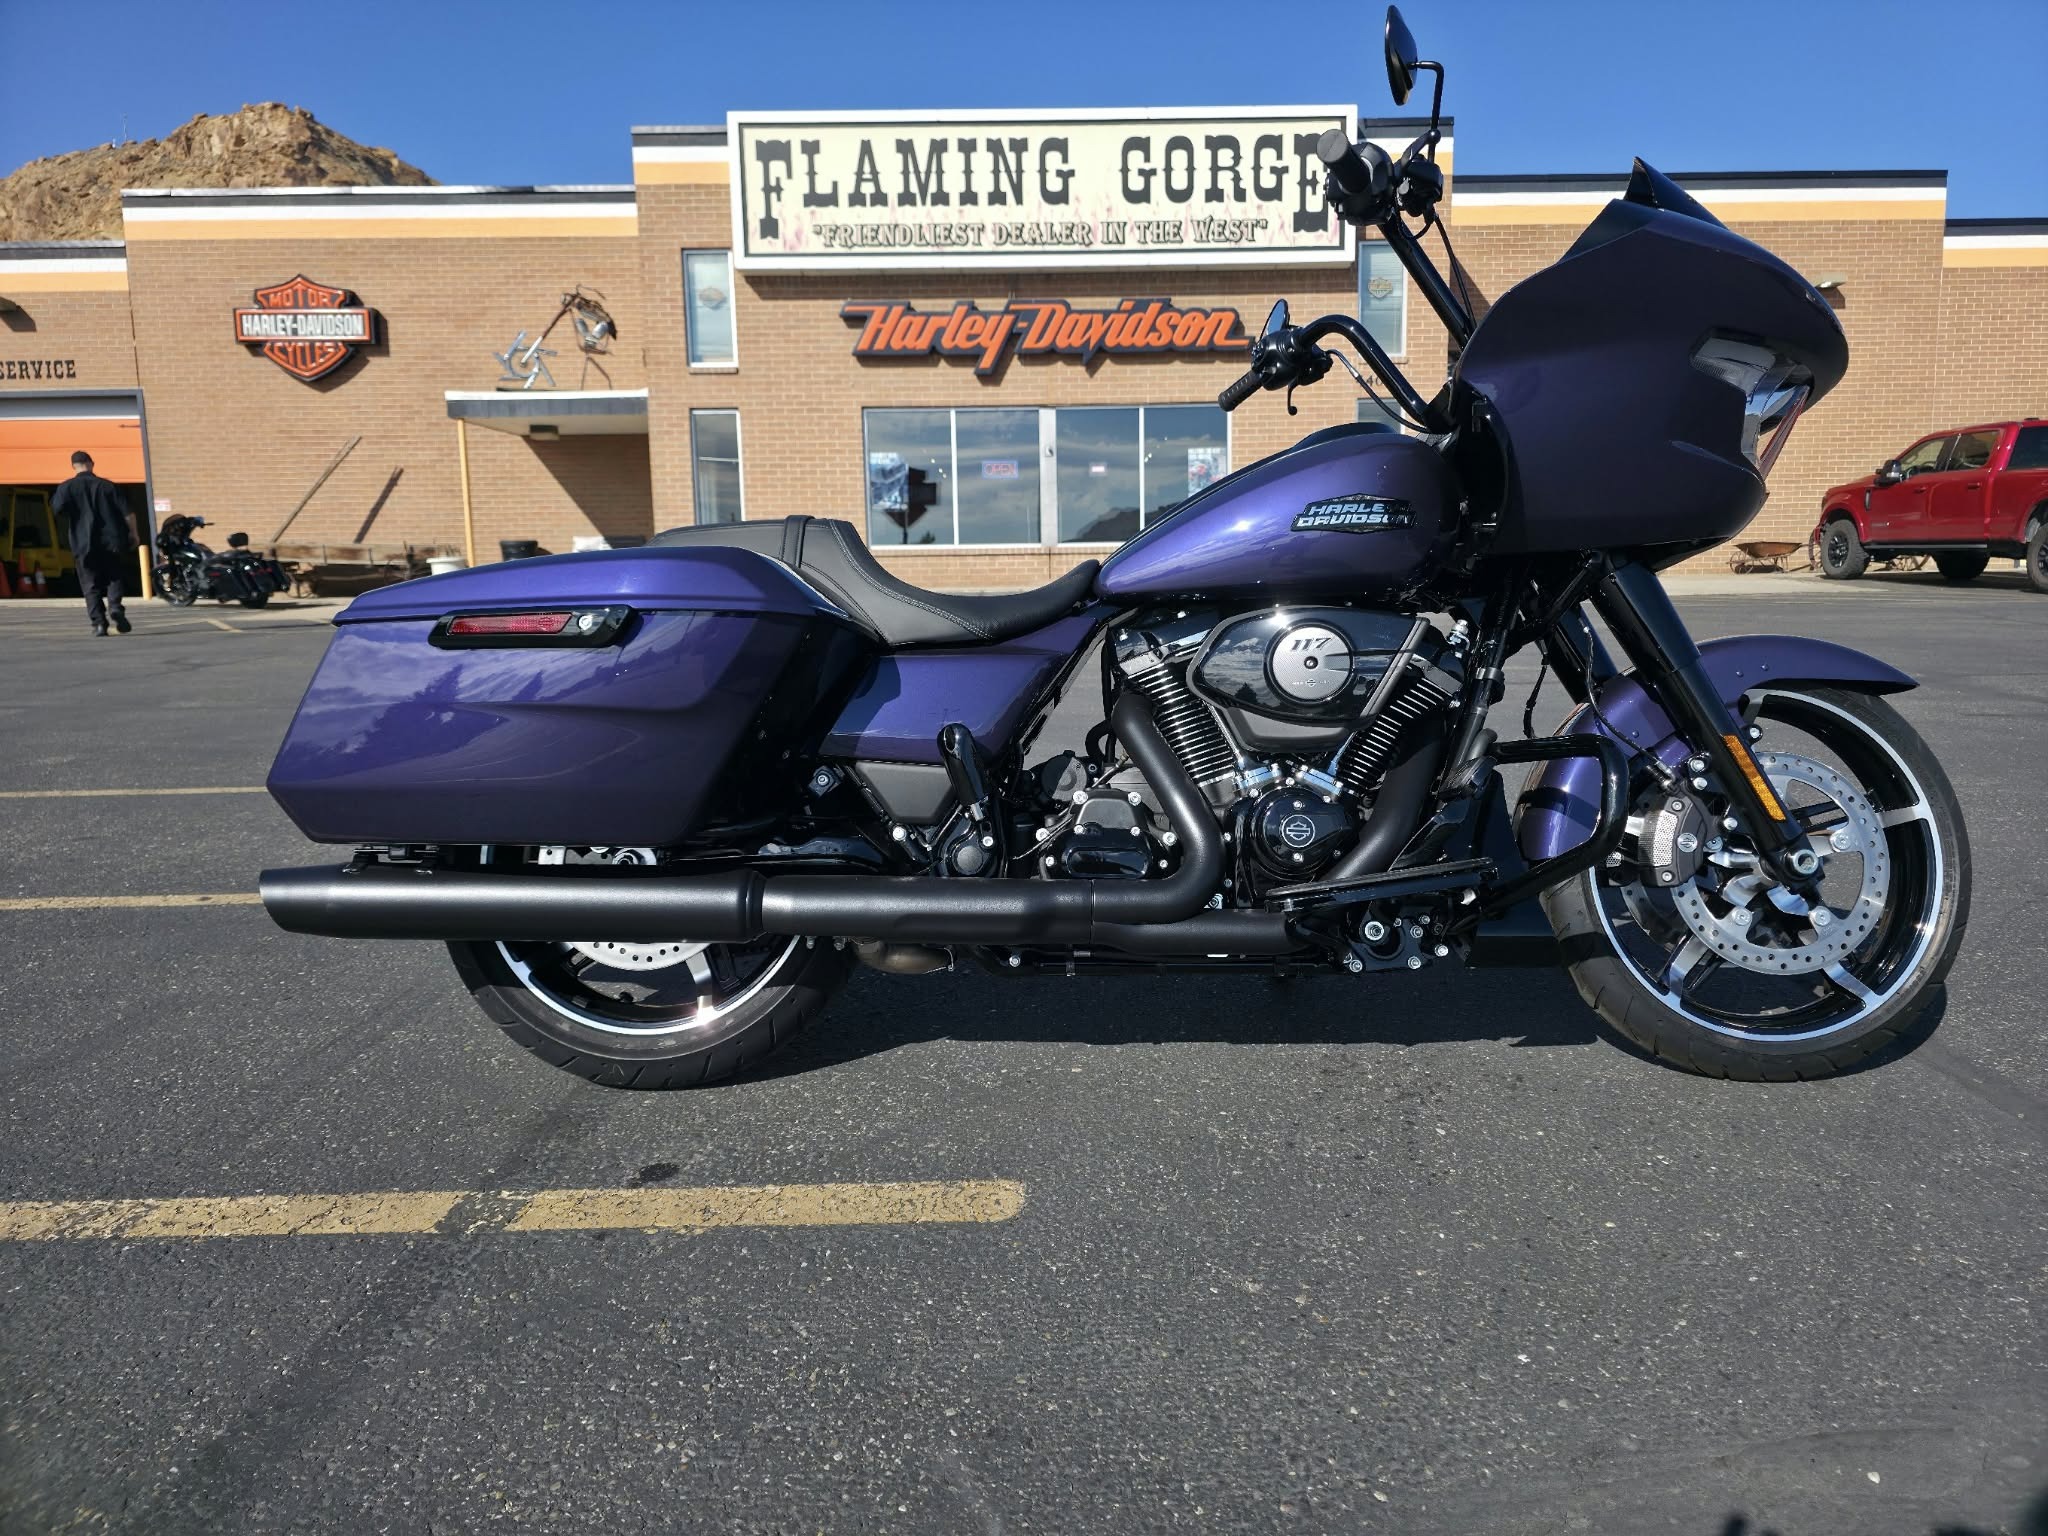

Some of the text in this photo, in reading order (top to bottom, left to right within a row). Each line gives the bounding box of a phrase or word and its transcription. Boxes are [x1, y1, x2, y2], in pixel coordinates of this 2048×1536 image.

[755, 133, 1330, 240] FLAMING GORGE
[812, 215, 1269, 248] "FRIENDLIEST DEALER IN THE WEST"
[268, 284, 333, 308] MOTOR
[241, 314, 364, 337] HARLEY-DAVIDSON
[844, 299, 1251, 370] Harley-Davidson
[273, 341, 337, 369] CYCLES
[985, 463, 1016, 475] OPEN
[1308, 503, 1394, 515] HARLE
[1291, 636, 1332, 651] 117
